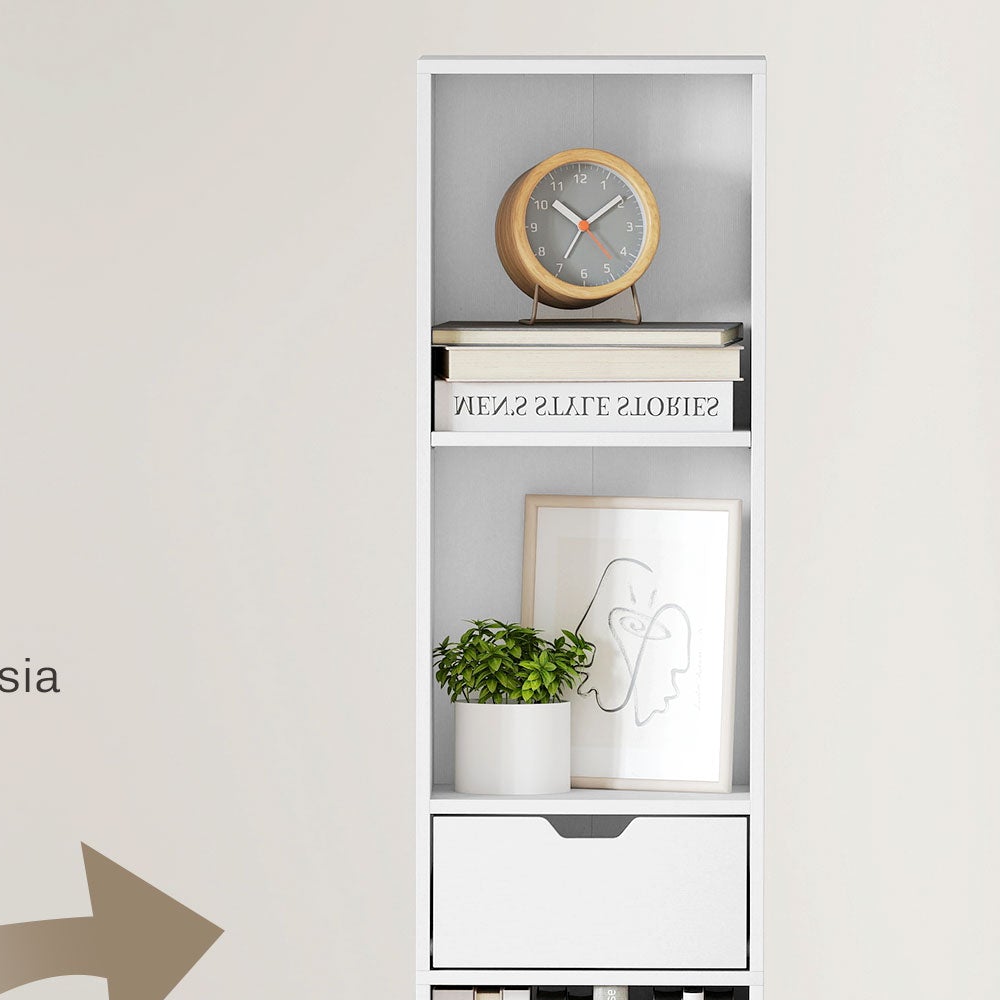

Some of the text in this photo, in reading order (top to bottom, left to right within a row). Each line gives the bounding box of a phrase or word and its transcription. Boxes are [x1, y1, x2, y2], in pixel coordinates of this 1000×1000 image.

[573, 174, 587, 184] 12
[550, 182, 564, 191] 11
[600, 180, 606, 190] 1
[534, 200, 548, 210] 10
[530, 222, 538, 232] 9
[626, 222, 634, 232] 3
[538, 246, 546, 256] 8
[620, 246, 628, 256] 4
[556, 263, 563, 272] 7
[604, 264, 610, 274] 5
[580, 269, 588, 278] 6
